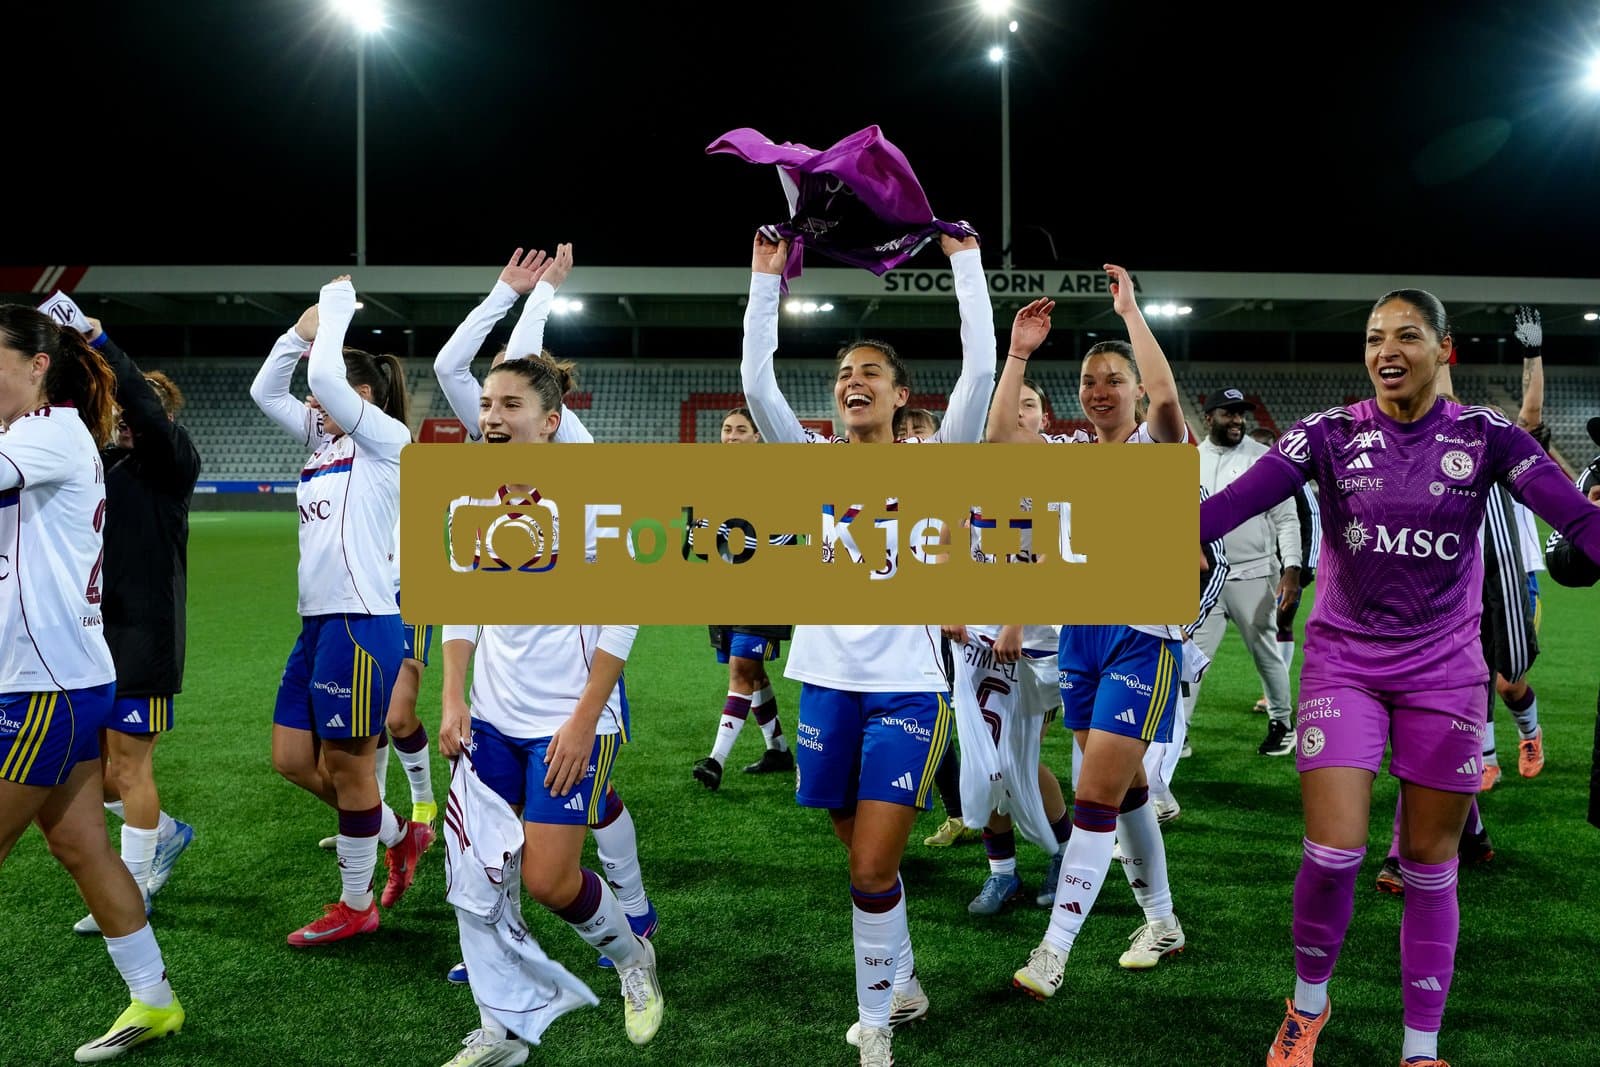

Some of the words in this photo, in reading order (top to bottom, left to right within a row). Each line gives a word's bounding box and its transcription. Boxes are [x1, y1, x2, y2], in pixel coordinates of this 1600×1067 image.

[885, 272, 1044, 293] STOCORN
[1058, 273, 1142, 293] AREA
[1343, 430, 1386, 449] AXA
[1373, 525, 1460, 560] MSC
[1065, 874, 1092, 890] SFC
[864, 956, 893, 966] SFC
